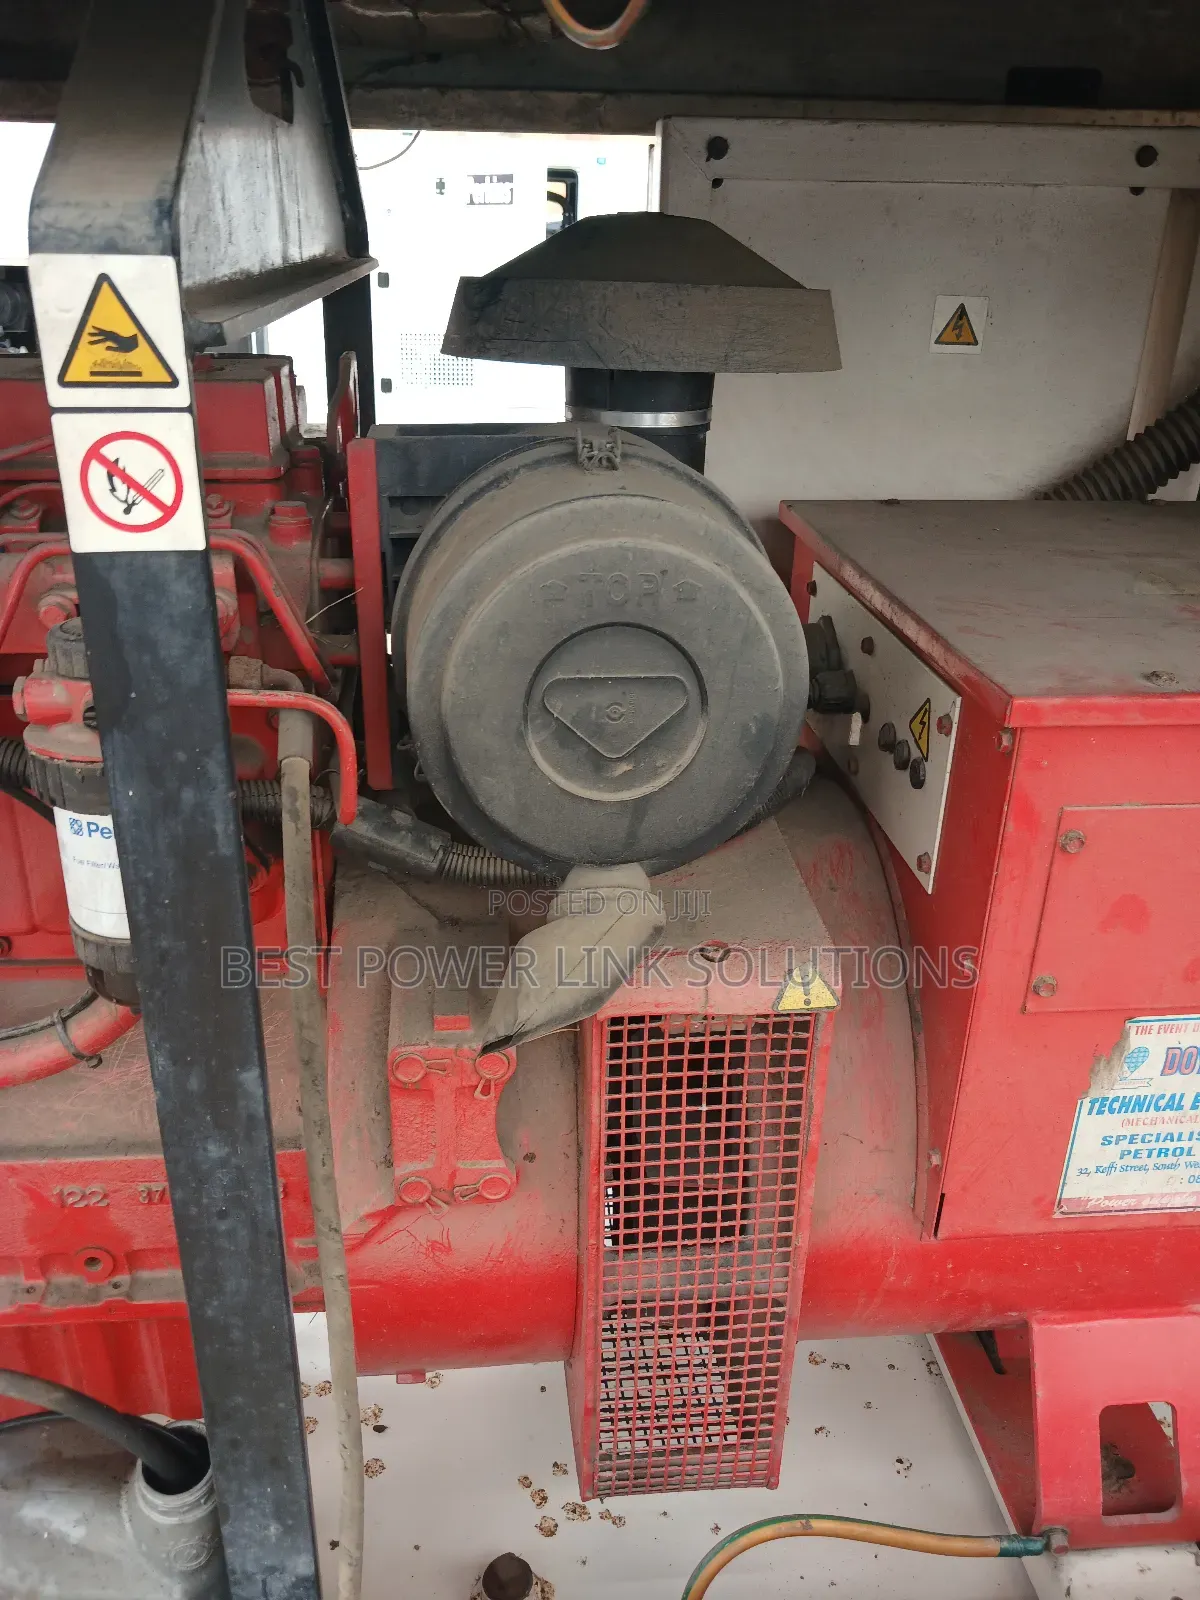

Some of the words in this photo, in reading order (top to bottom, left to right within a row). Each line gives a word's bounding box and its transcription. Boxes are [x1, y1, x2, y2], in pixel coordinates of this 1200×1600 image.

[579, 572, 660, 607] TOP
[87, 821, 113, 839] Pe
[1135, 1024, 1154, 1036] THE
[1157, 1022, 1188, 1035] EVENT
[1160, 1045, 1200, 1077] DO
[1087, 1093, 1185, 1115] TECHNICAL
[1119, 1146, 1196, 1161] PETROL
[1120, 1163, 1149, 1174] Street,
[1152, 1158, 1180, 1172] South
[53, 1184, 110, 1208] 122
